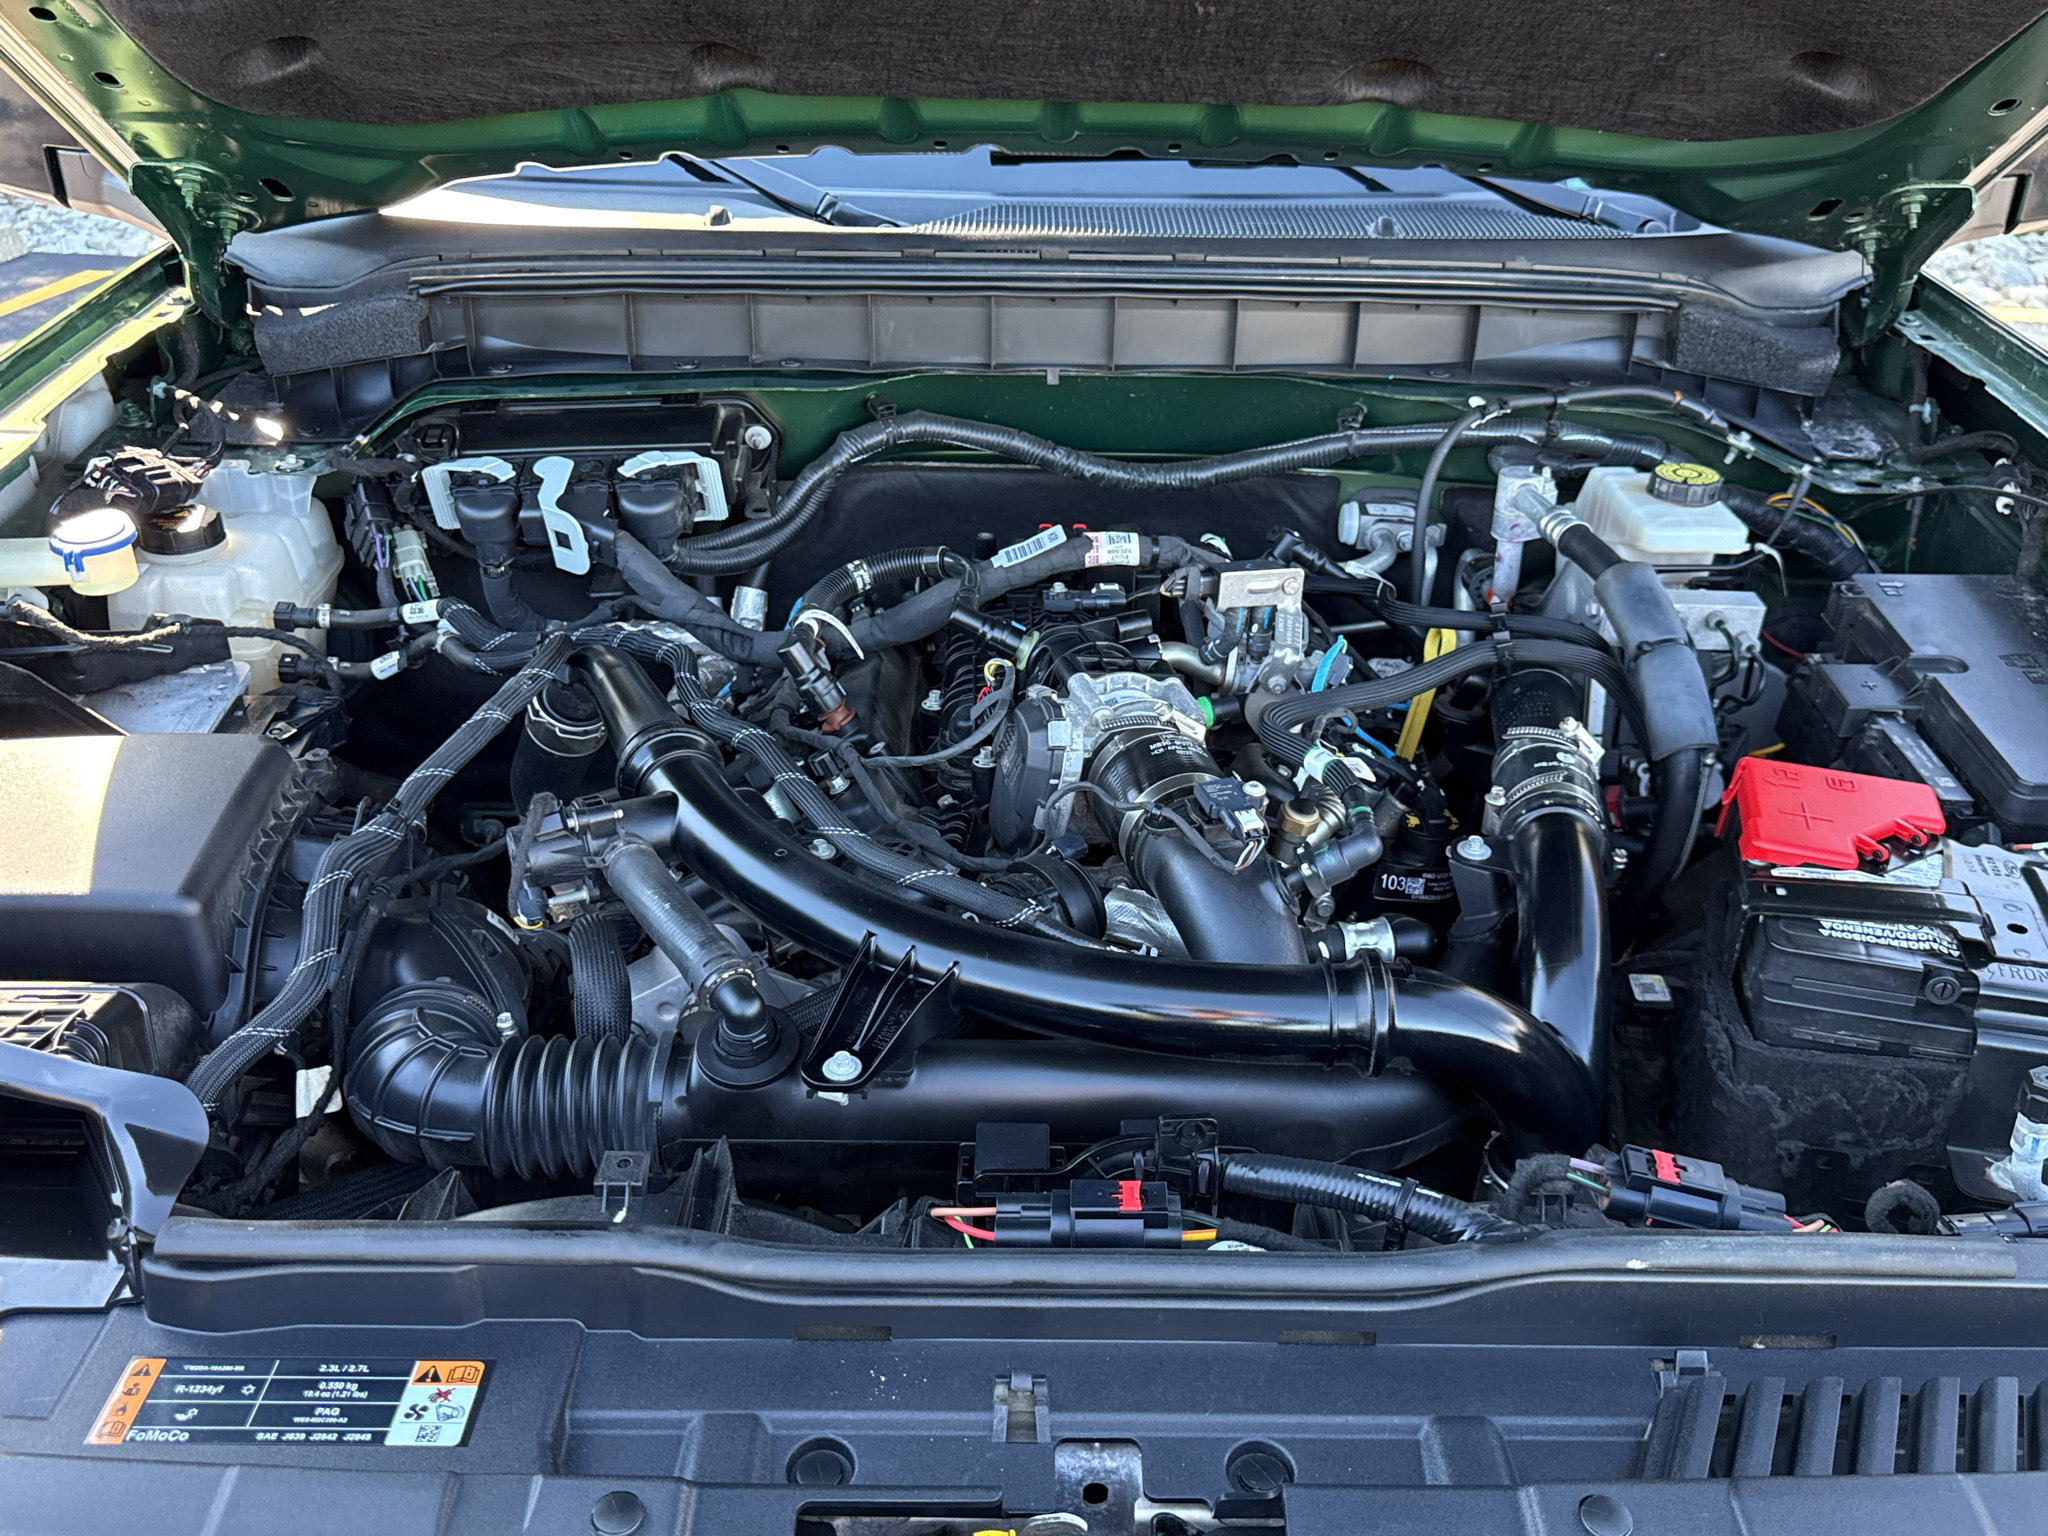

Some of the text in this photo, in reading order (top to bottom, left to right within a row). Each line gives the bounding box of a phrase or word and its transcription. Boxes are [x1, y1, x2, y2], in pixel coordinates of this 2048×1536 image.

[1380, 873, 1407, 891] 103
[318, 1364, 341, 1373] 2.3L
[348, 1364, 370, 1373] 2.7L
[174, 1383, 226, 1397] R-1234yf
[345, 1382, 359, 1391] kg
[314, 1407, 341, 1416] PAG
[126, 1429, 190, 1442] FoMoCo
[256, 1432, 279, 1441] SAE
[281, 1432, 306, 1441] J639
